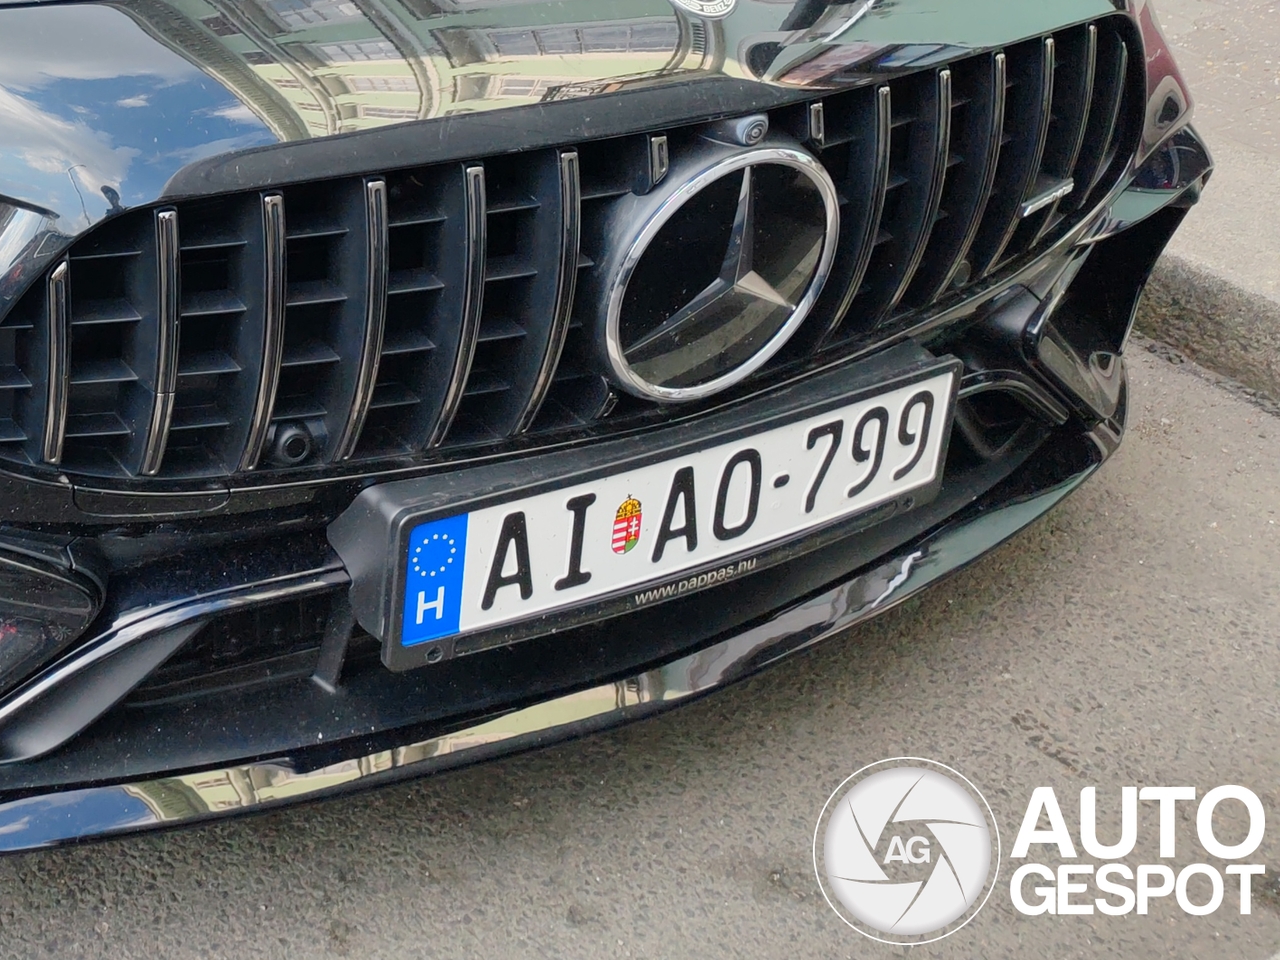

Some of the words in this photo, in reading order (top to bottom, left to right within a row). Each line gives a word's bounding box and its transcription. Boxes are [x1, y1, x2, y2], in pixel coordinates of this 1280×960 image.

[703, 3, 728, 13] BENZ
[634, 557, 757, 606] www.pappas.hu
[415, 585, 444, 626] H
